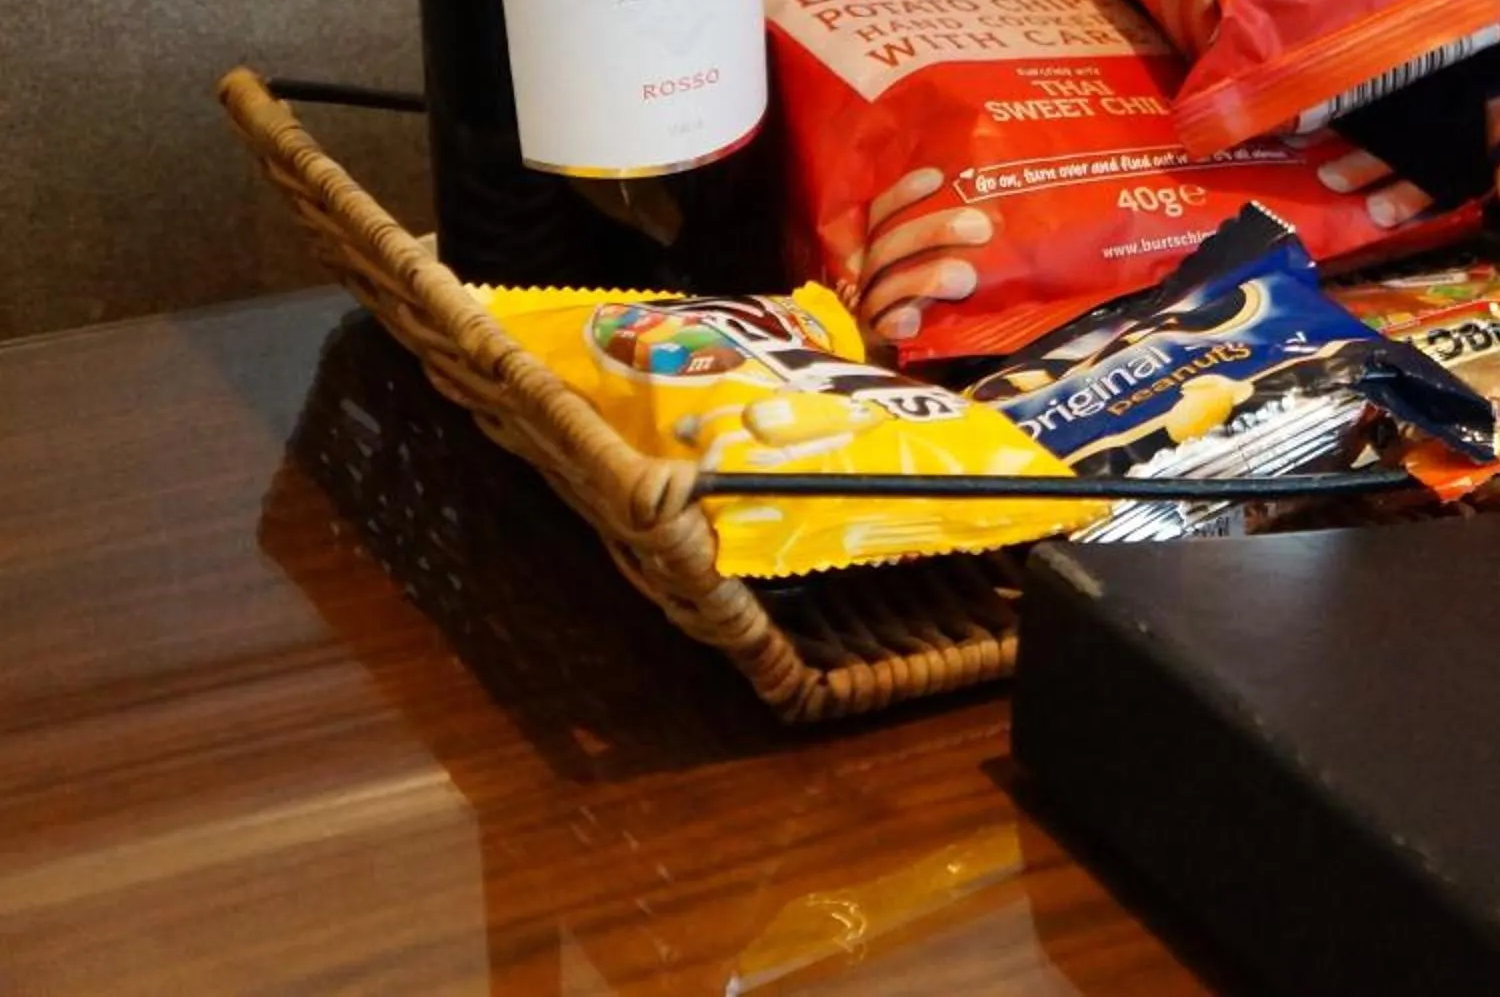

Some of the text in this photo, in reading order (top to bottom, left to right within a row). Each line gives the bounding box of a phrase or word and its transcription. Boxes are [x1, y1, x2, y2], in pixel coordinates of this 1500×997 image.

[854, 17, 963, 43] HAND
[865, 29, 1124, 68] WITH CAR
[642, 68, 720, 100] ROSSO
[1031, 79, 1114, 96] THAI
[984, 96, 1170, 122] SWEET CHIL
[975, 174, 996, 193] Go
[1024, 168, 1057, 185] turn
[1059, 162, 1089, 179] over
[1092, 157, 1119, 175] and
[1120, 154, 1151, 172] find
[1102, 228, 1217, 258] www.burtschi
